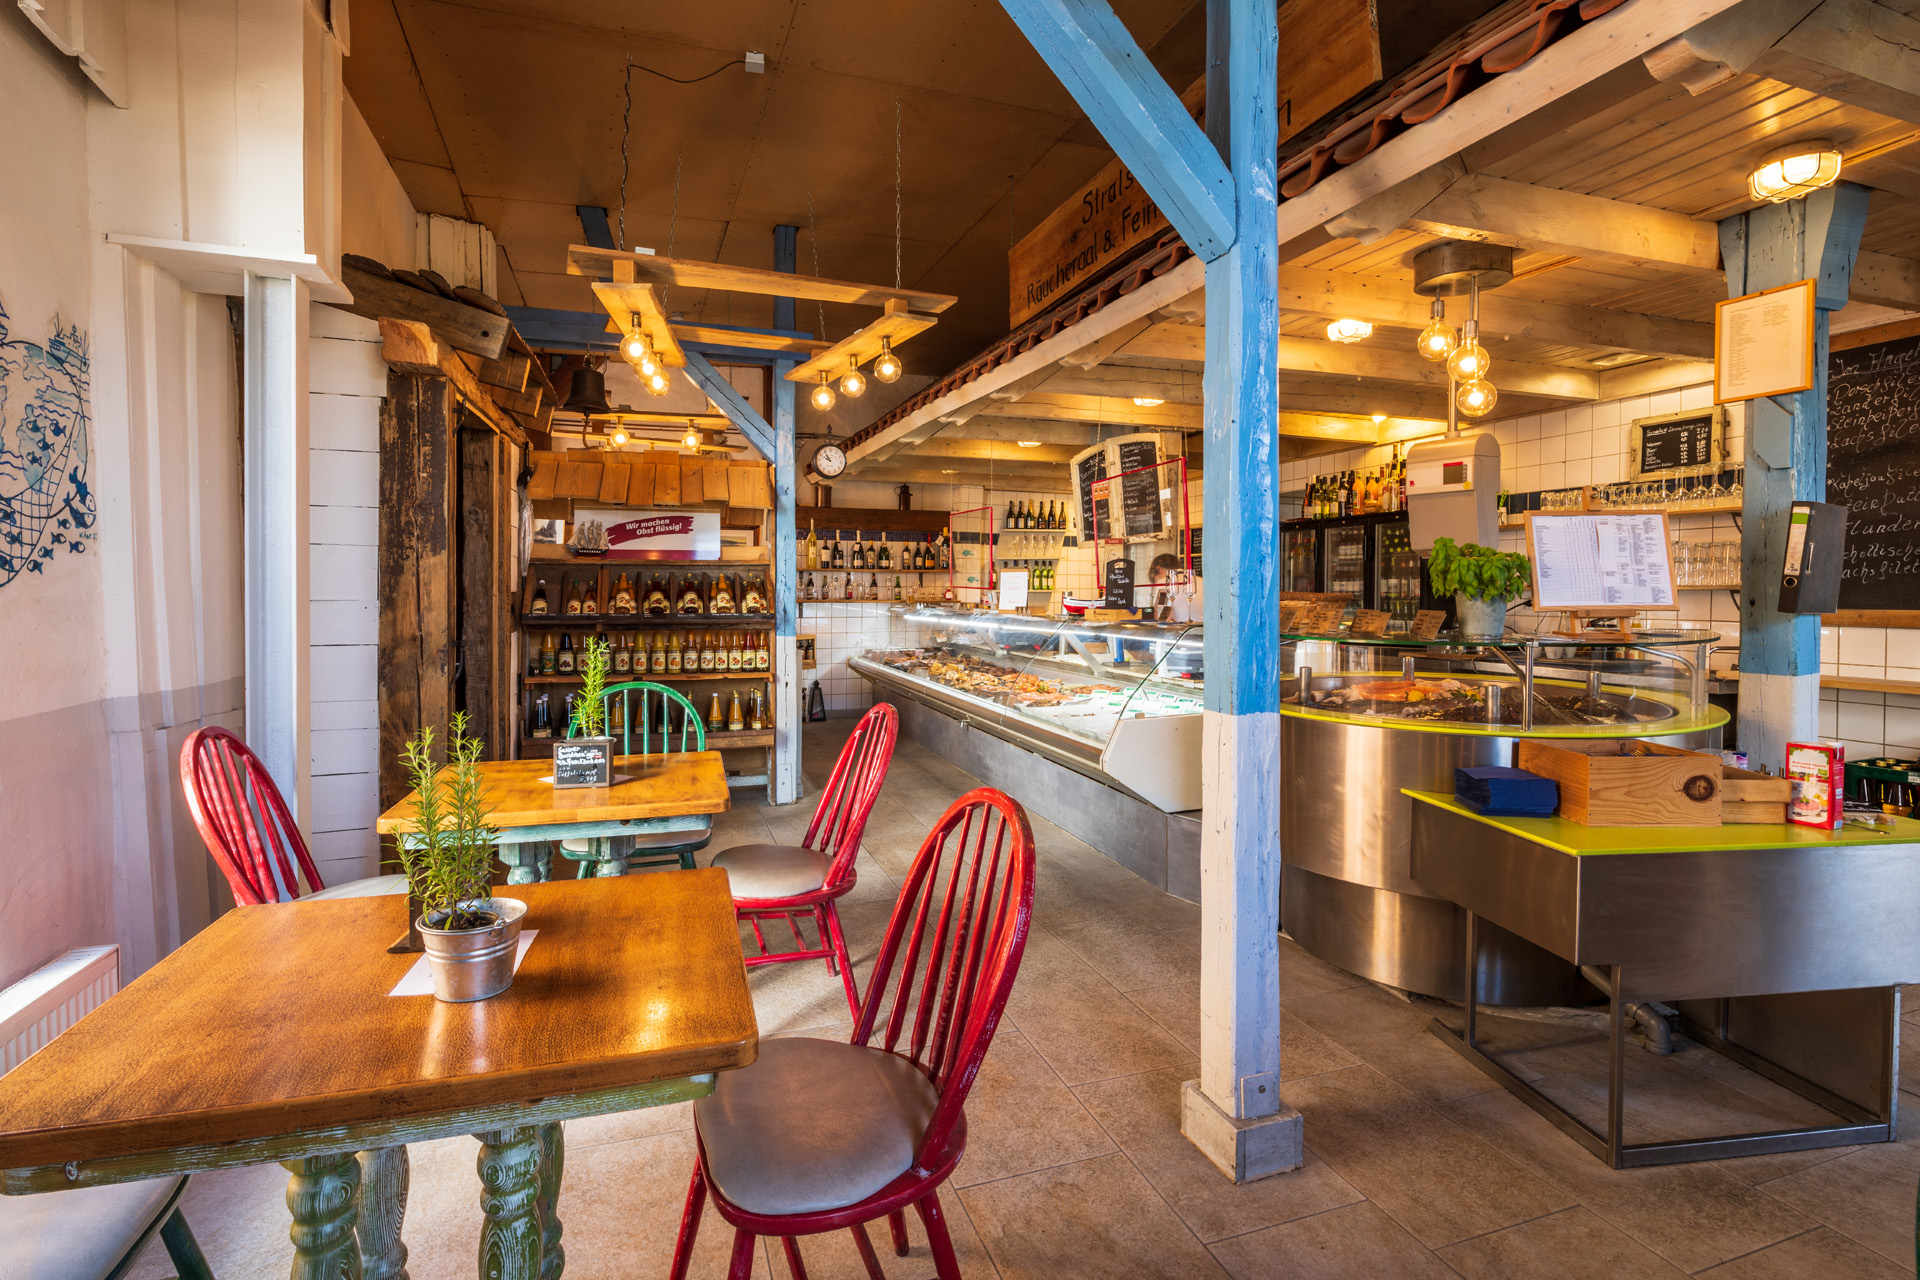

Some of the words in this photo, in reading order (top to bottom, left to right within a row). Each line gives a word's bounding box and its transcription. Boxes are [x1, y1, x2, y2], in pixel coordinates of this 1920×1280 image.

[1082, 168, 1134, 224] Strals
[1027, 232, 1098, 309] Räucheraal
[1103, 229, 1116, 254] &
[1122, 200, 1157, 241] Fein
[1830, 386, 1920, 415] Zanderfil
[1833, 373, 1920, 401] Dorschfile
[1831, 400, 1920, 431] Steinbeißerf
[1830, 418, 1920, 453] Lachsfile
[1832, 462, 1920, 498] Kabeljaufile
[625, 522, 640, 530] Wir
[640, 519, 670, 528] machen
[636, 527, 654, 535] Obst
[655, 522, 682, 532] flüssig!
[1842, 539, 1920, 563] chottische
[1841, 559, 1920, 584] achsfilet
